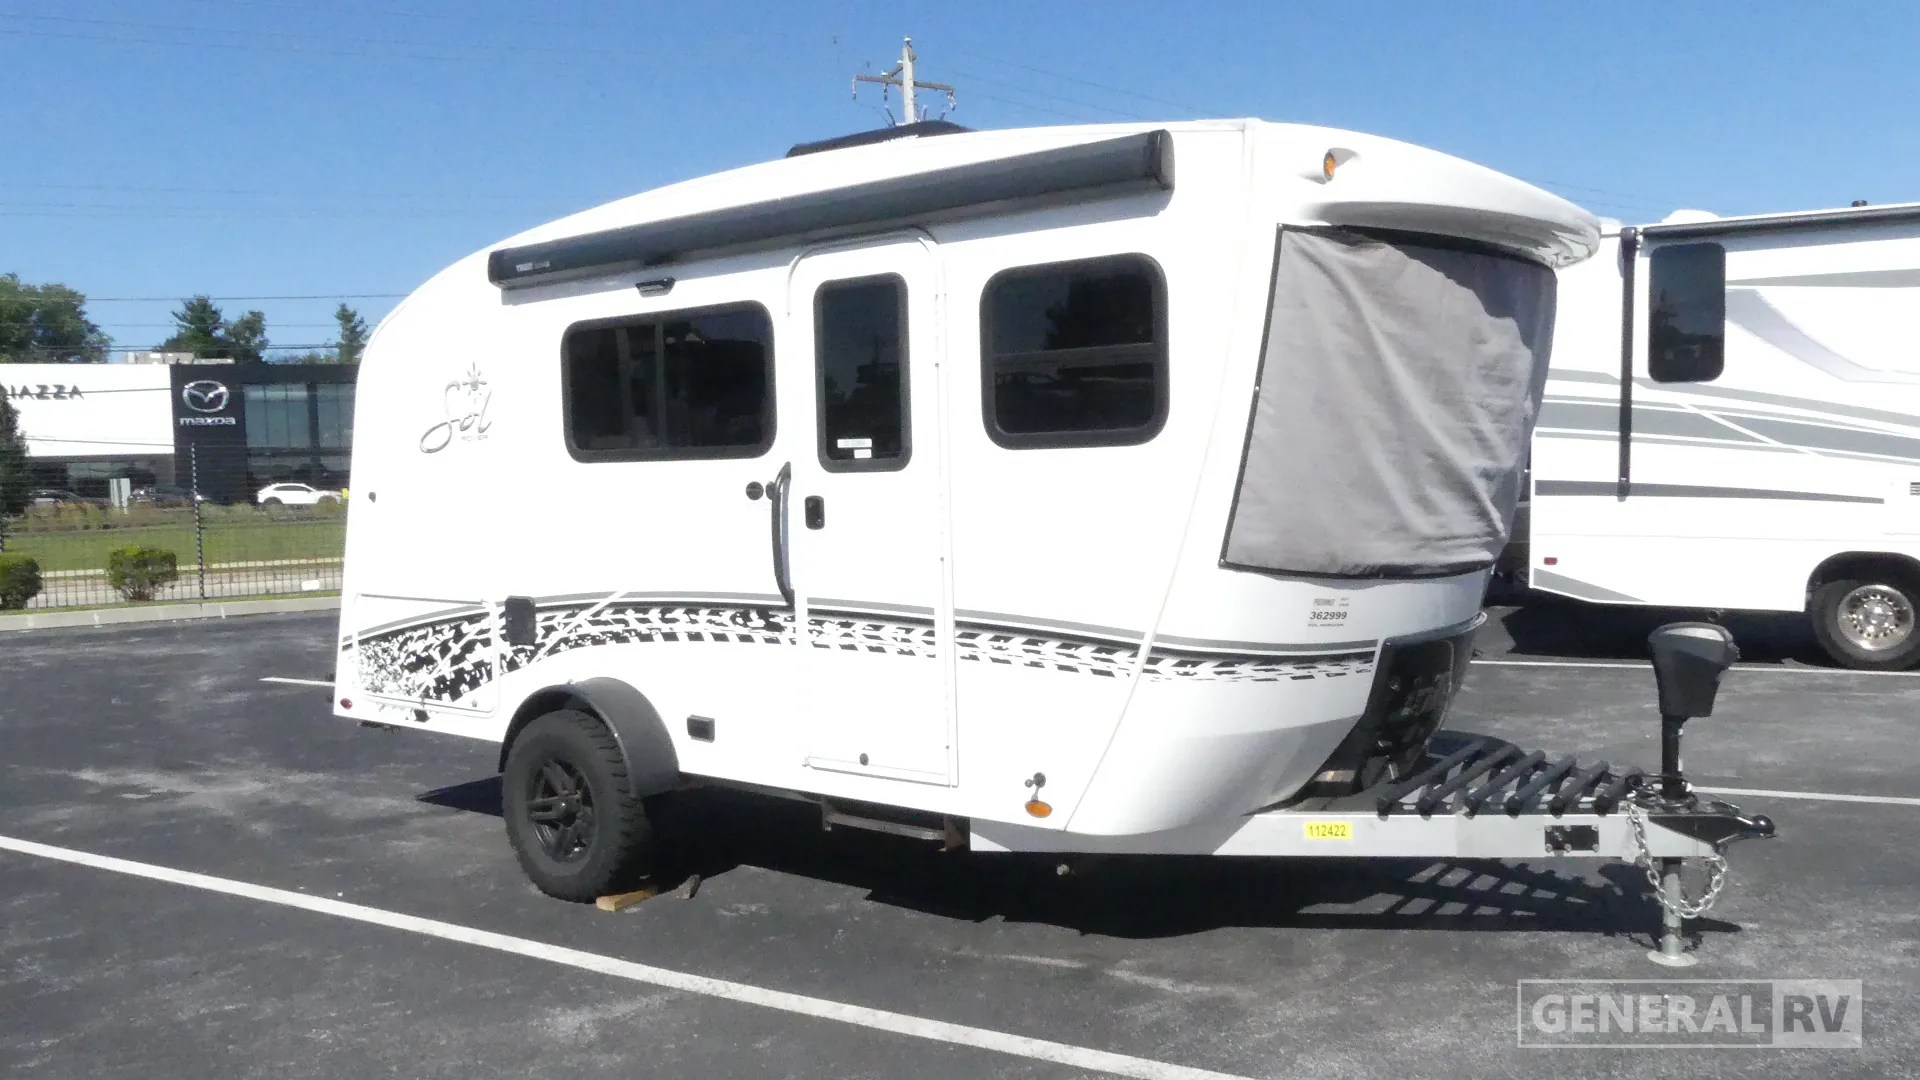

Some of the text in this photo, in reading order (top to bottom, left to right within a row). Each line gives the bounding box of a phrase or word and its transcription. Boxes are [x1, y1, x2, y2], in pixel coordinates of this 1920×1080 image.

[8, 384, 85, 401] IAZZA
[179, 416, 236, 426] mazda
[1310, 611, 1348, 620] 362999
[1309, 824, 1346, 837] 112422
